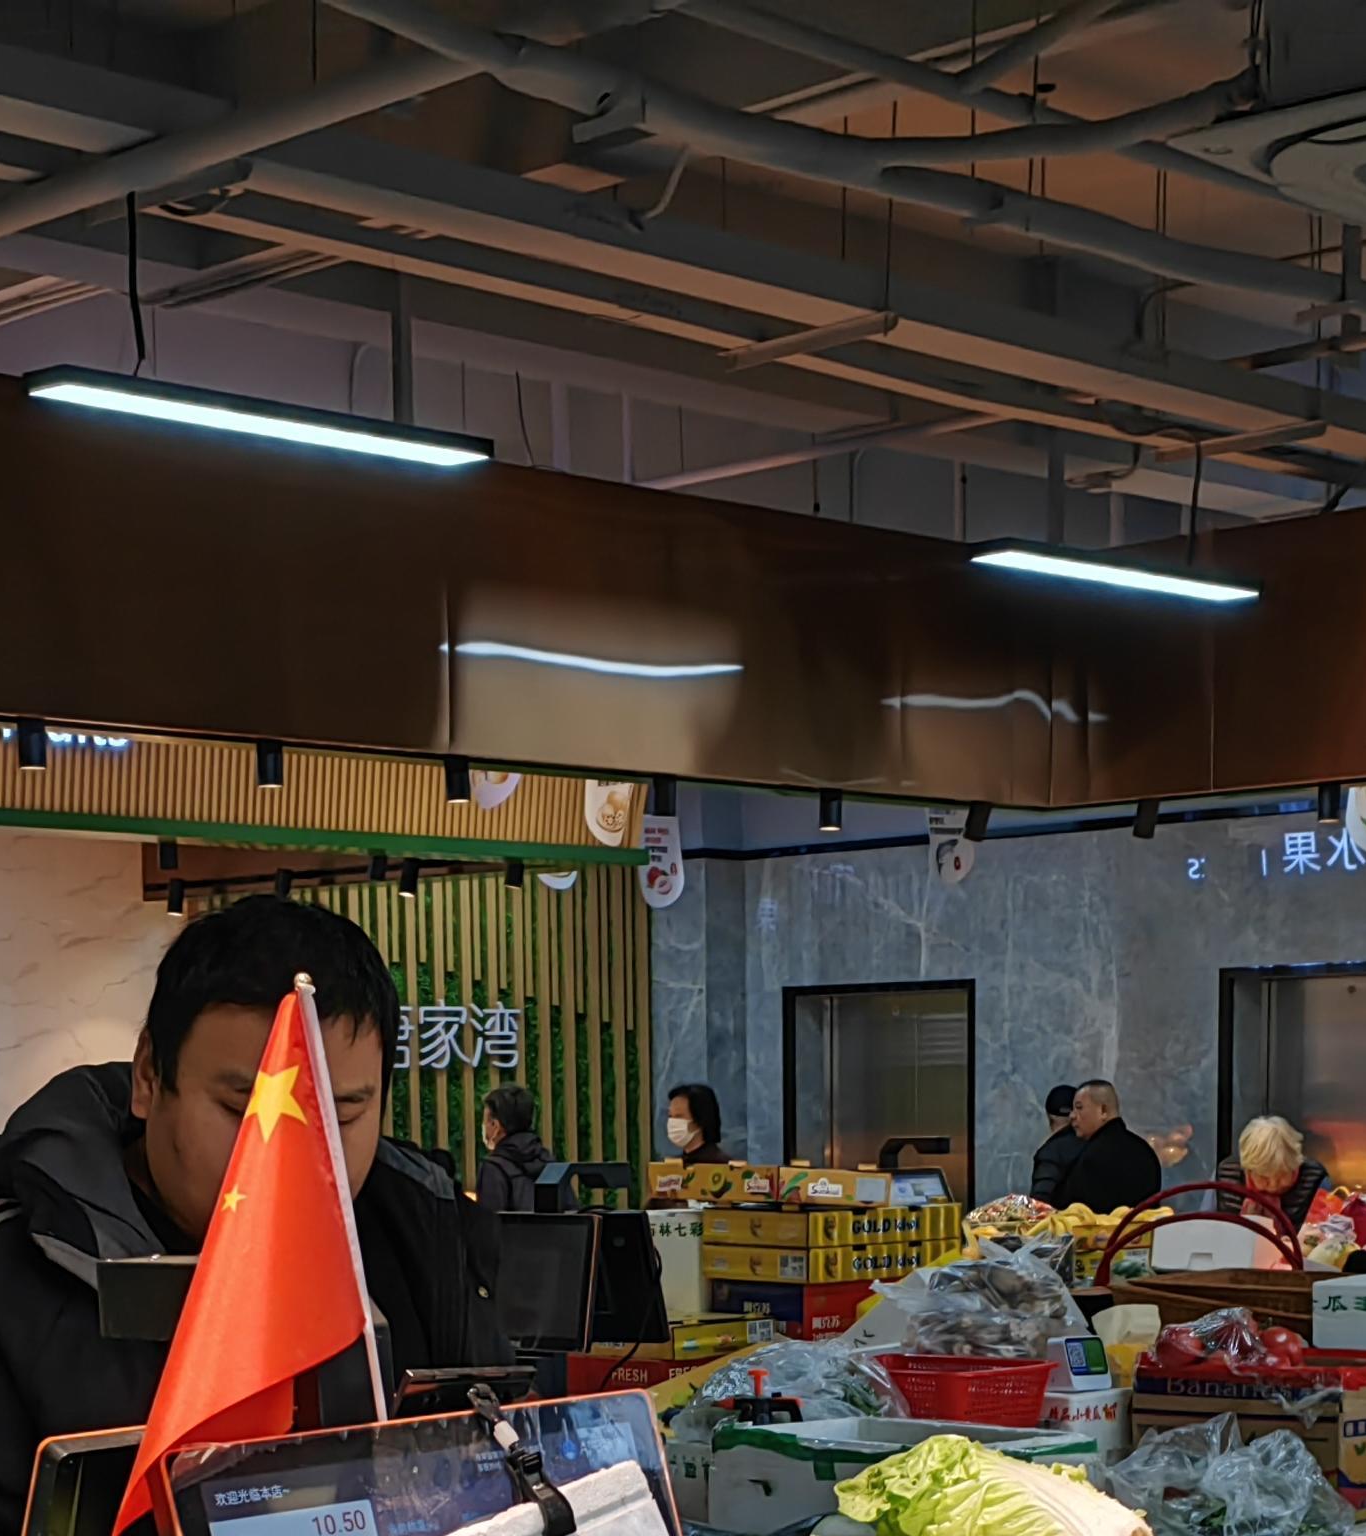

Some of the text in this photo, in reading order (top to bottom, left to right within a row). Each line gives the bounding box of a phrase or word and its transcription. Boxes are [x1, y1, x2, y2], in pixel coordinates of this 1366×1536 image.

[852, 1218, 891, 1235] GOLD
[852, 1255, 892, 1271] GOLD
[311, 1510, 366, 1536] 10.50
